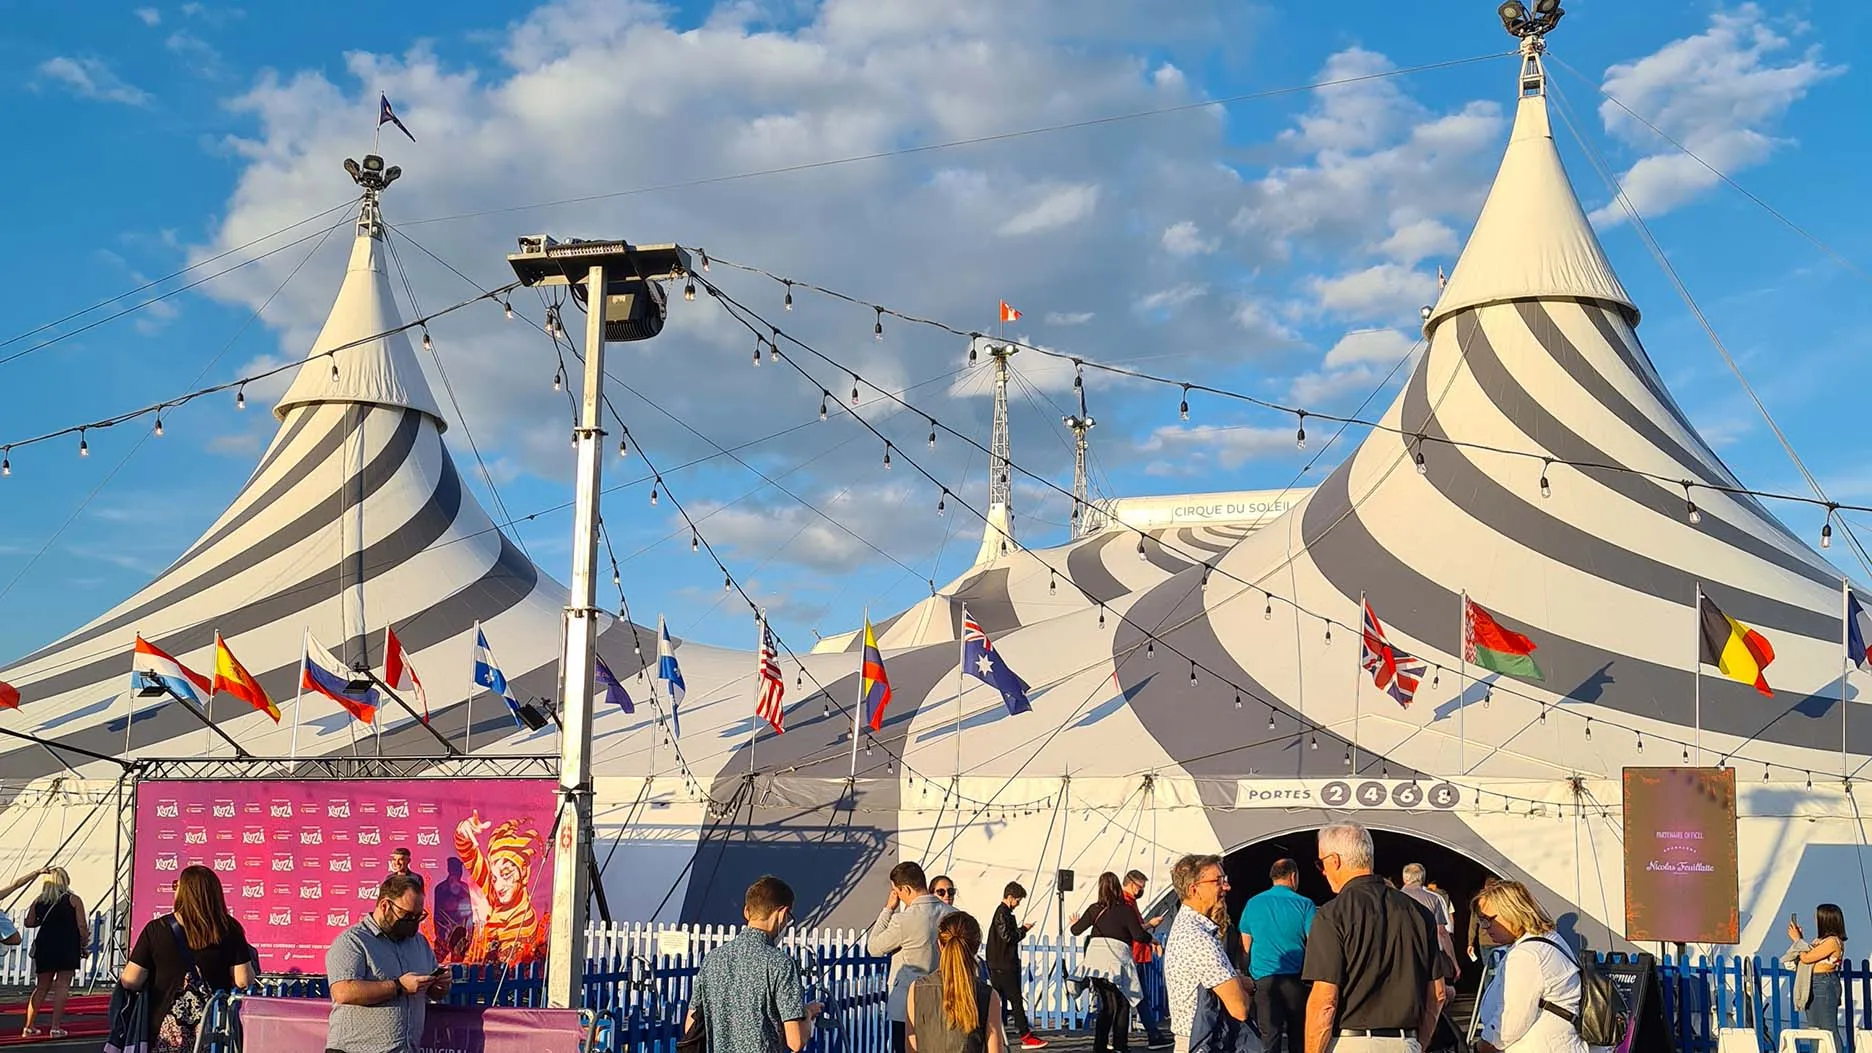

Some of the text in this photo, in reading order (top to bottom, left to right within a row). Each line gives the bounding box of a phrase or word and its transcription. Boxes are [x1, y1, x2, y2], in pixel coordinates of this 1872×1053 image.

[1174, 501, 1290, 519] CIRQUE DU SOLEIL
[1248, 786, 1451, 804] PORTES 2 4 6 8
[1646, 860, 1676, 872] Nicolas
